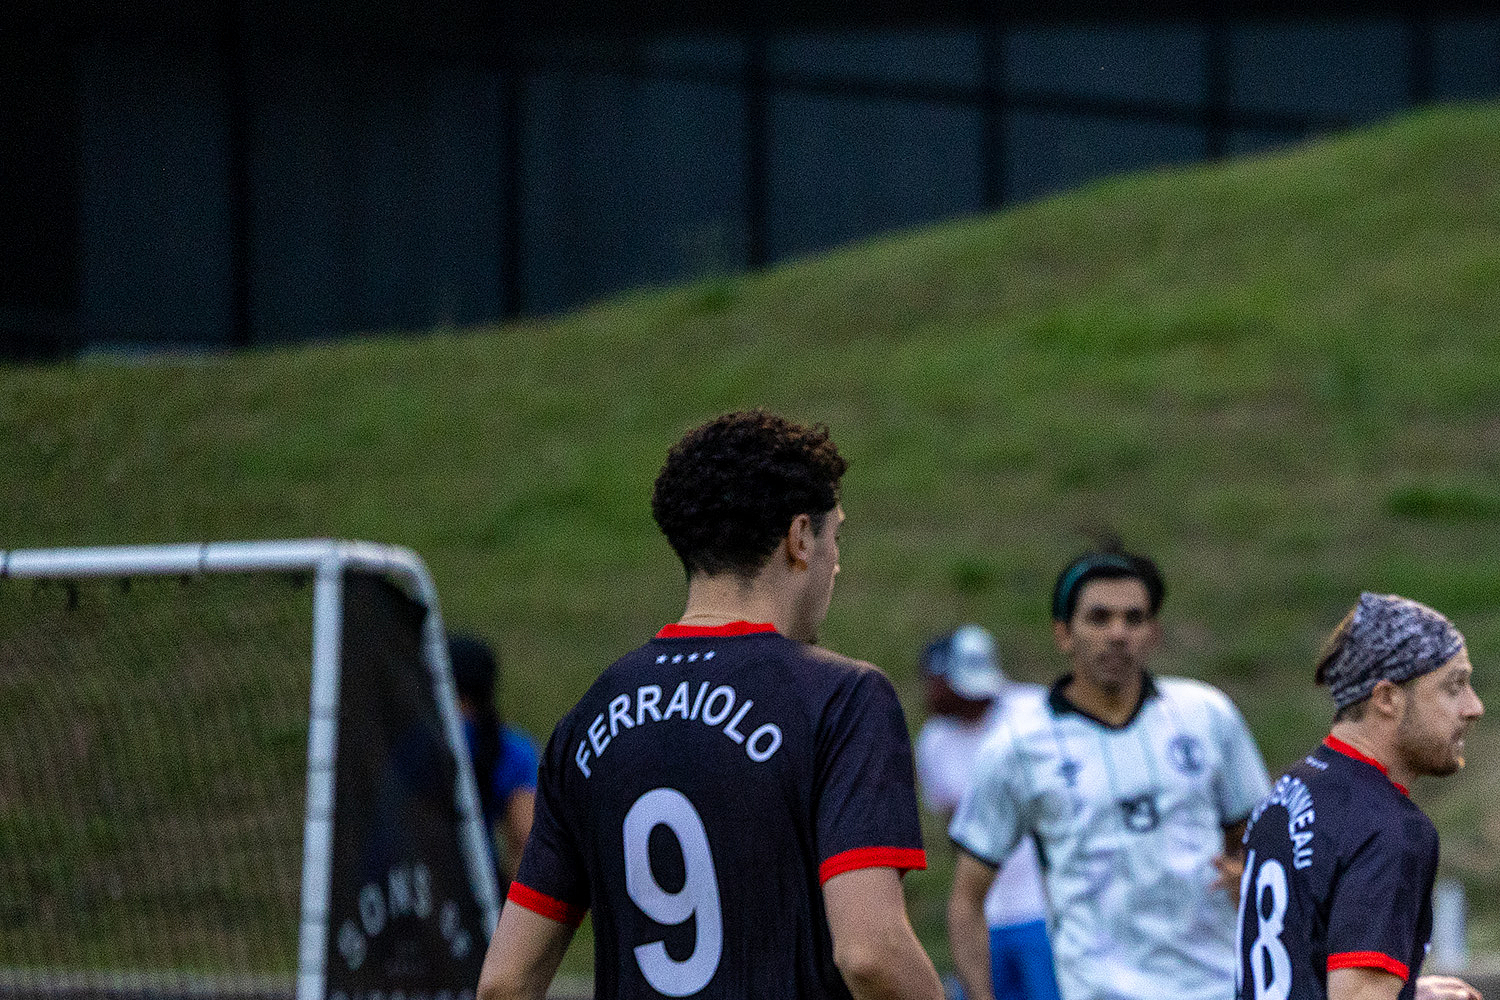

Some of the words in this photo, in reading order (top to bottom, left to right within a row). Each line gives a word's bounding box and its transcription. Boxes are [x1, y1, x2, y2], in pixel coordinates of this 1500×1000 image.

[574, 680, 783, 779] FERRAIOLO
[337, 862, 432, 972] SONS
[622, 787, 724, 998] 9
